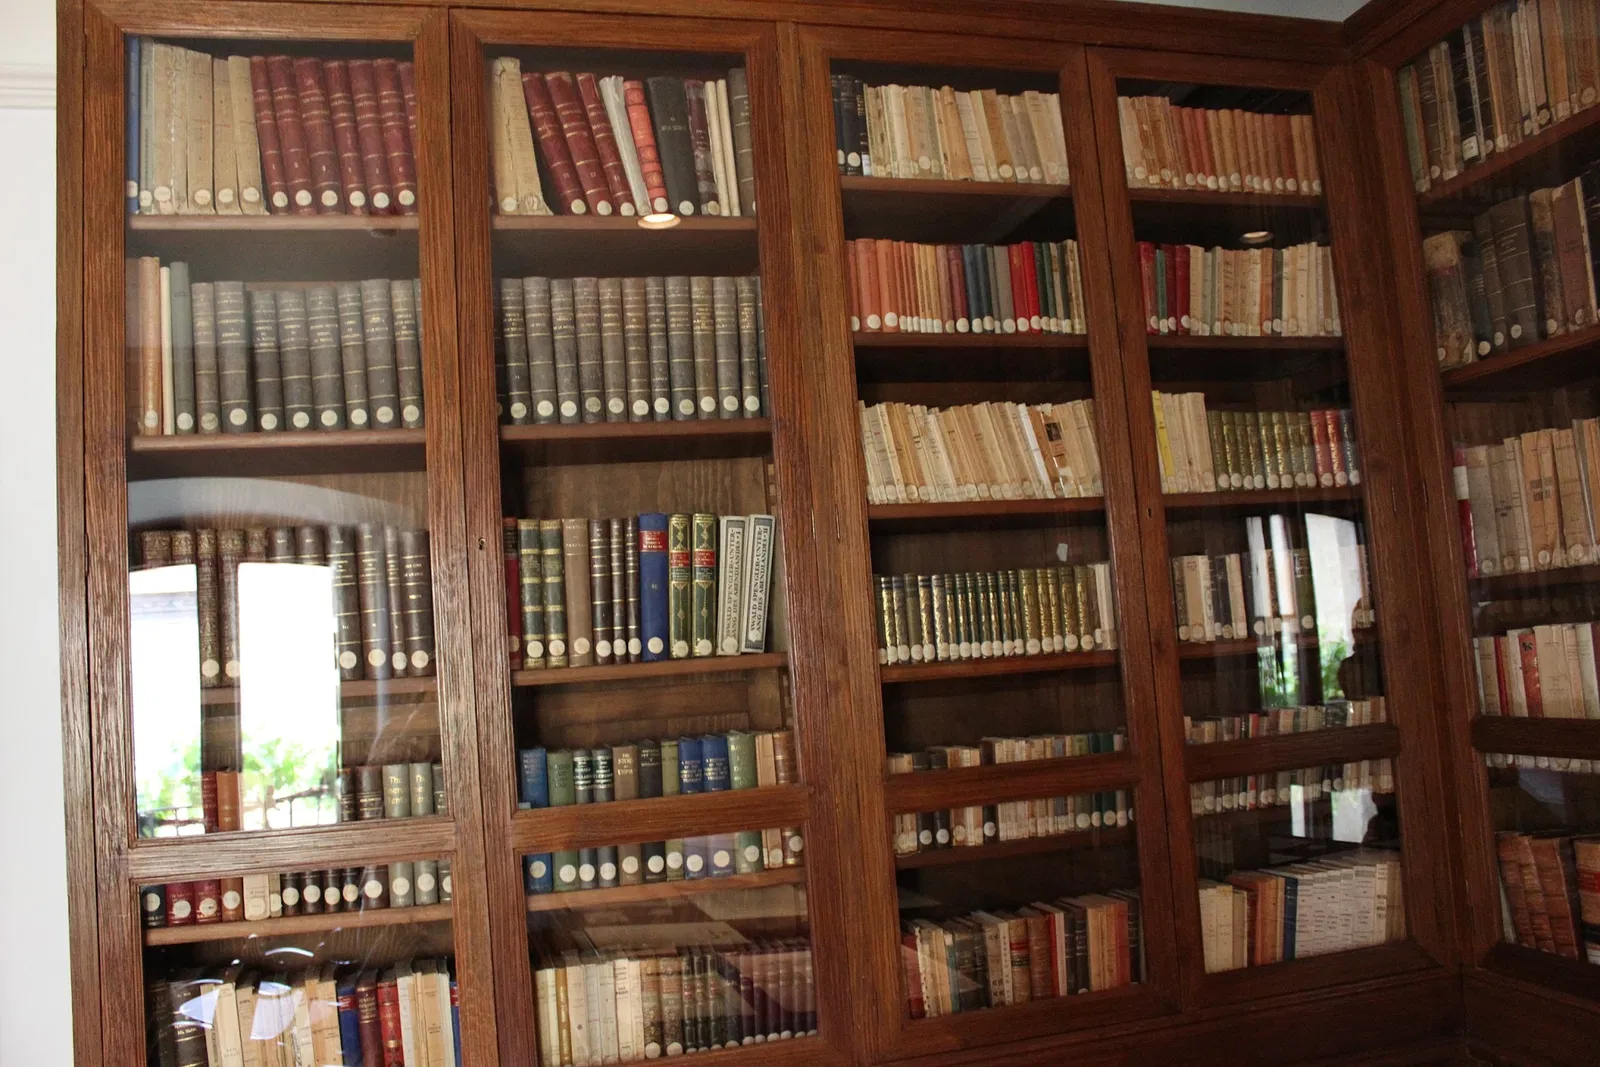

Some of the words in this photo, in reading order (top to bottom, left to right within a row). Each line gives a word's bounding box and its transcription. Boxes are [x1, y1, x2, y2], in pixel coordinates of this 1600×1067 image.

[727, 563, 735, 604] SPENGLER
[733, 541, 741, 597] ABENDLANDES
[752, 561, 761, 602] SPENGLER
[759, 539, 768, 594] ABENDLANDES
[724, 606, 732, 639] SWALD
